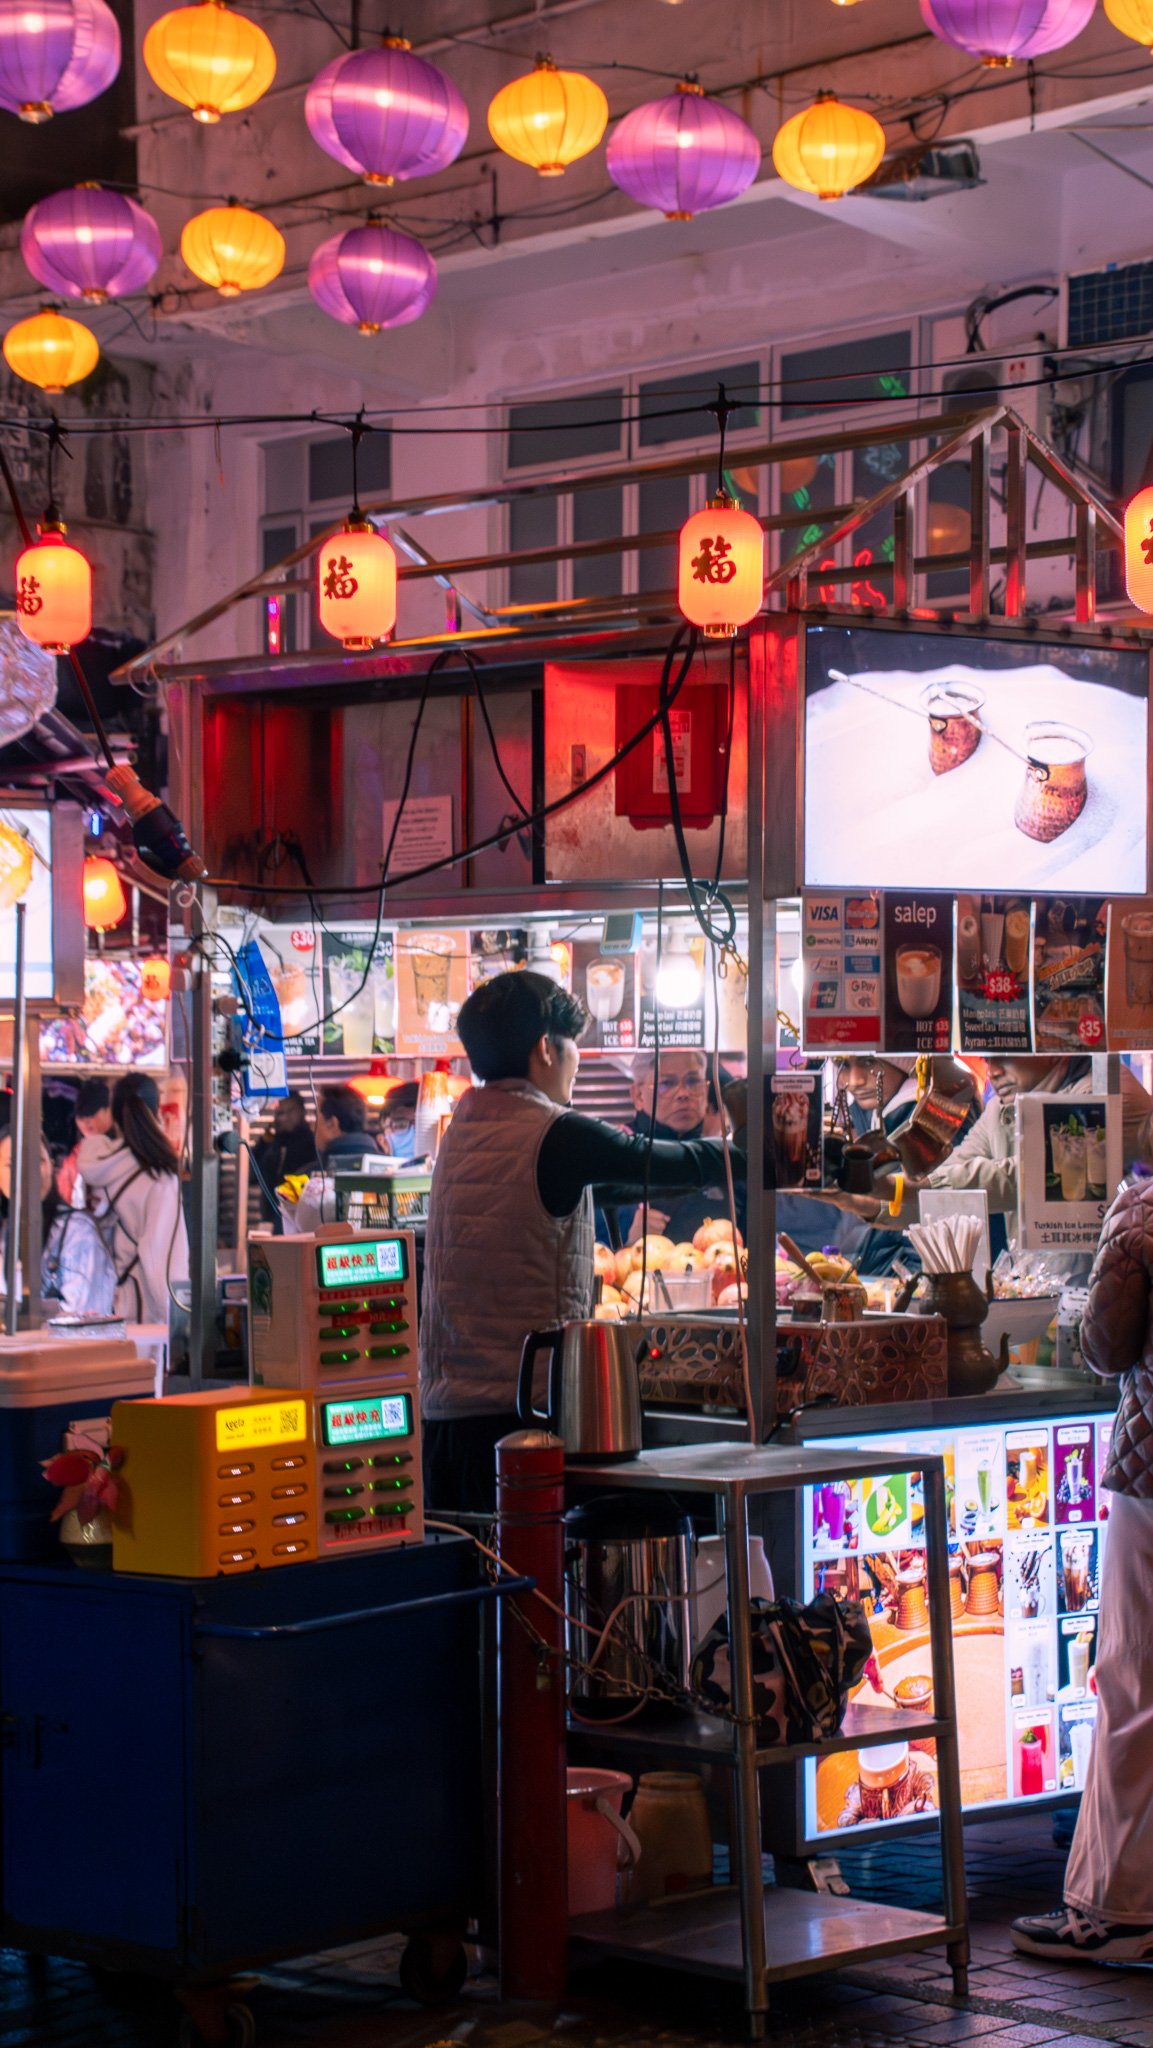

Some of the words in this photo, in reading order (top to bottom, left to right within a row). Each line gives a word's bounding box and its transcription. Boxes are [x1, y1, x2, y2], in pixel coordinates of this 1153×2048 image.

[691, 535, 737, 584] 福
[323, 555, 358, 600] 福
[810, 905, 838, 921] VISA
[895, 901, 936, 928] salep
[292, 930, 315, 946] $30
[856, 935, 878, 946] Alipay
[989, 976, 1011, 993] $38
[916, 1021, 933, 1033] HOT
[1080, 1020, 1101, 1038] $35
[604, 1035, 618, 1046] ICE
[917, 1037, 933, 1049] ICE
[1034, 1221, 1063, 1230] Turkish
[1064, 1221, 1076, 1230] Ice
